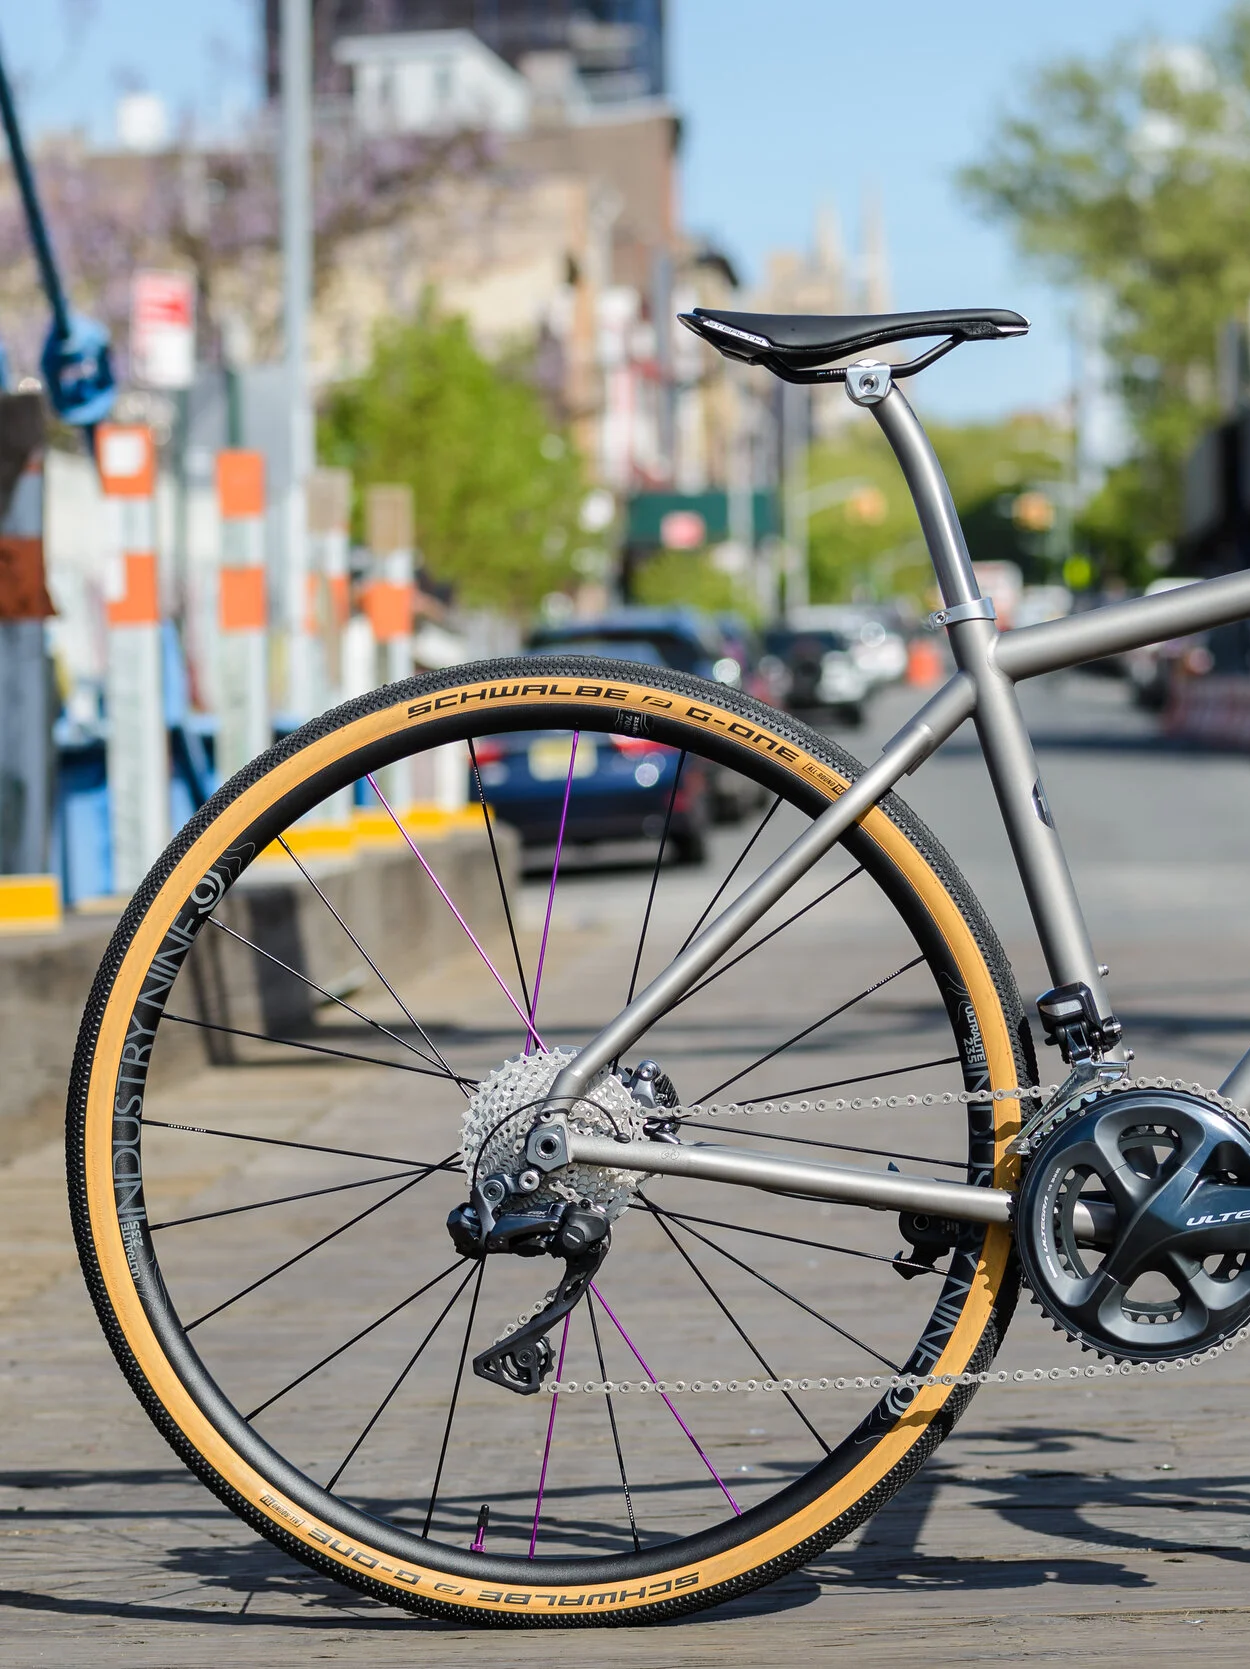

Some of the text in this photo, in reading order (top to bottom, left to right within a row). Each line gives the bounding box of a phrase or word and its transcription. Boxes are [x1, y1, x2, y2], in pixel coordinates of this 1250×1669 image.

[706, 319, 764, 345] STEALTH
[407, 684, 630, 719] SCHWALBE
[685, 706, 800, 763] G-ONE
[963, 1036, 977, 1064] 235
[965, 1005, 986, 1062] ULTRALITE
[112, 1016, 156, 1223] INDUSTRY
[121, 1222, 141, 1280] ULTRALITE
[130, 1220, 144, 1247] 235
[307, 1527, 700, 1606] SCHWALBE G-ONE
